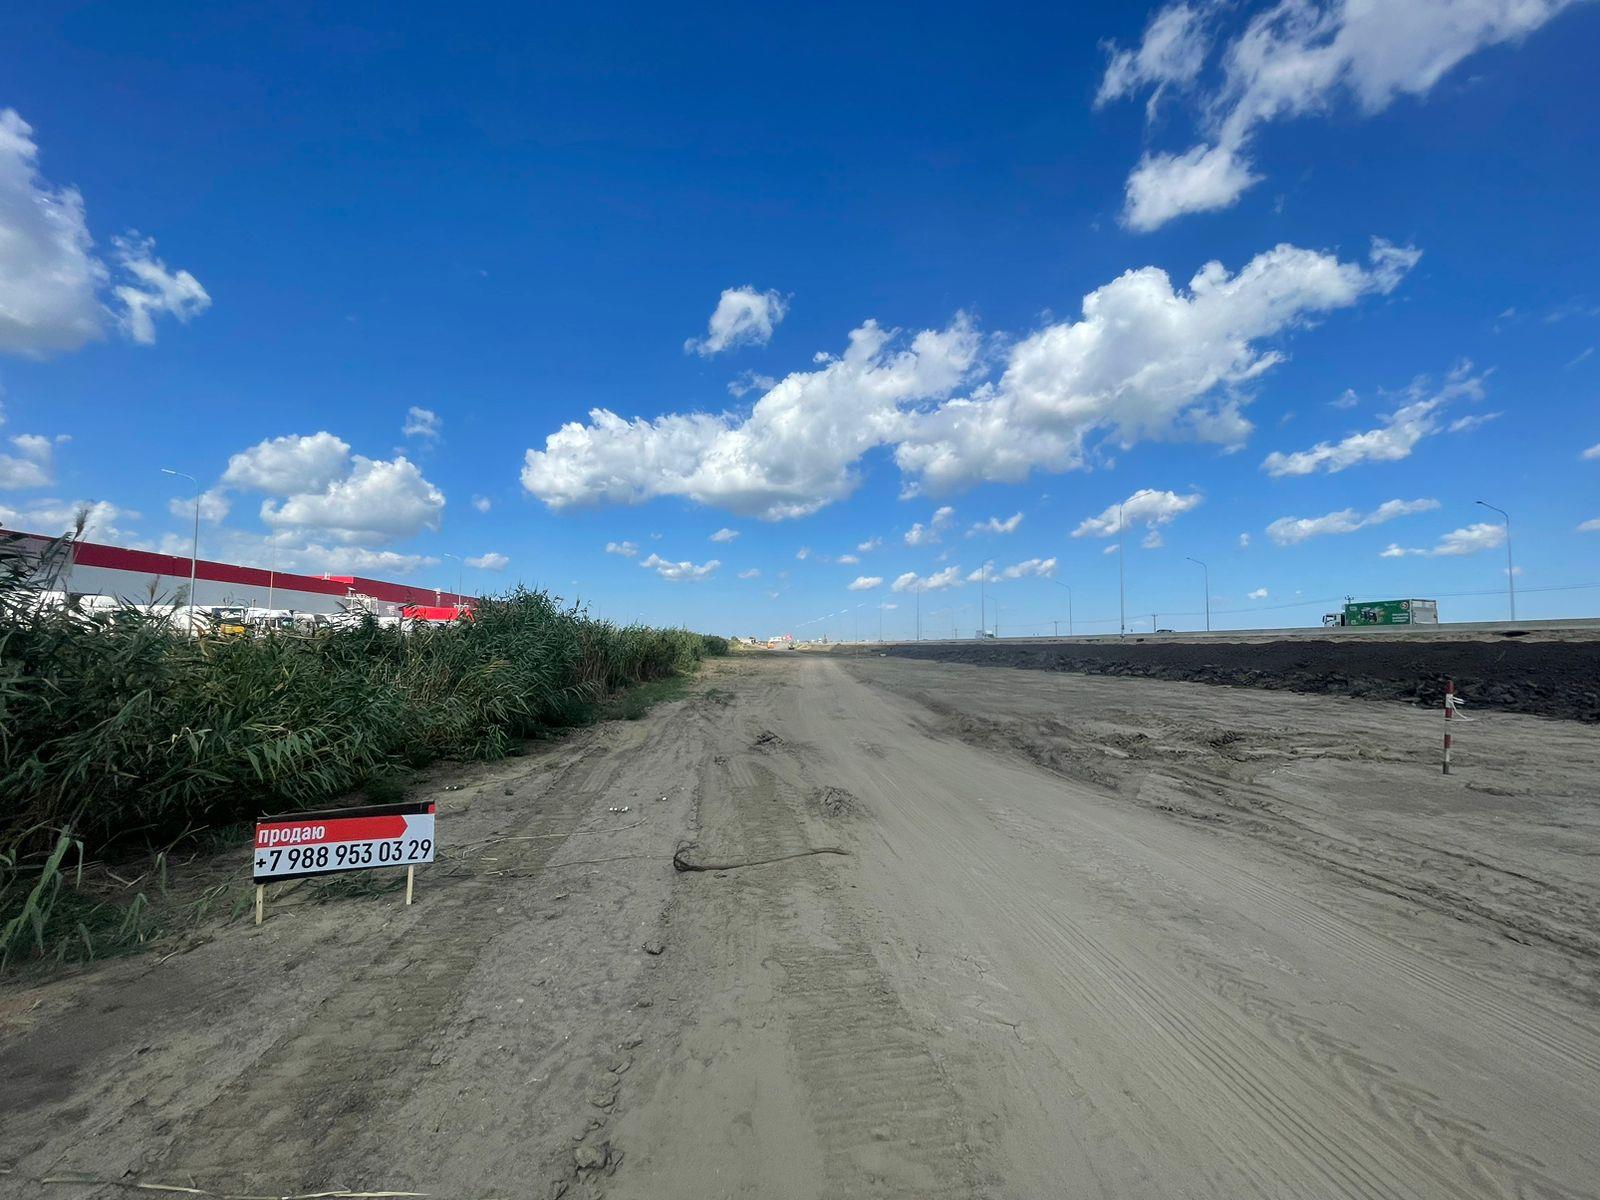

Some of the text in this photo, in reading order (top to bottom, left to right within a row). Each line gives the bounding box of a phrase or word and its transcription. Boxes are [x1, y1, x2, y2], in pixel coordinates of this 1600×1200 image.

[258, 825, 326, 847] продаю
[255, 838, 432, 872] +7 988 953 03 29
